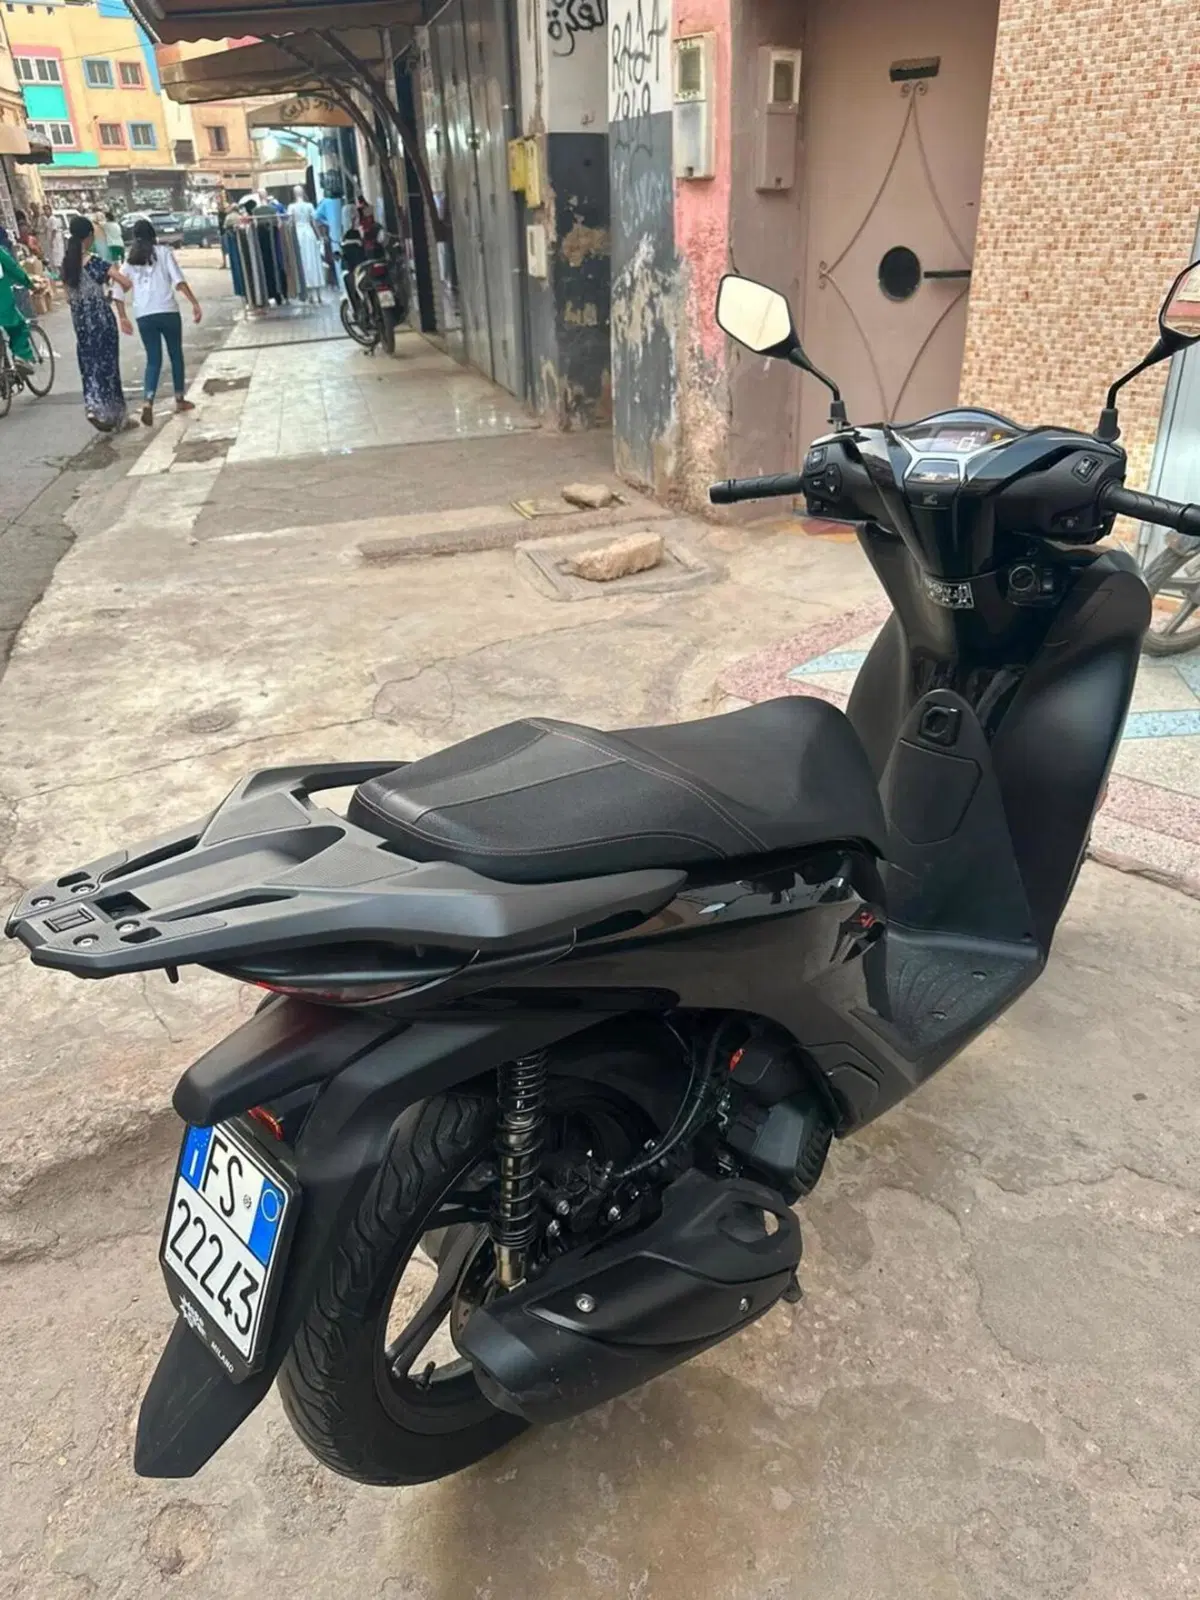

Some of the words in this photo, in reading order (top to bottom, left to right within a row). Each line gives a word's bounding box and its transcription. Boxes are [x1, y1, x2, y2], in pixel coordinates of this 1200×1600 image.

[612, 0, 668, 92] RAJA
[202, 1134, 243, 1217] FS
[169, 1198, 260, 1336] 22243
[211, 1340, 234, 1373] MILANO
